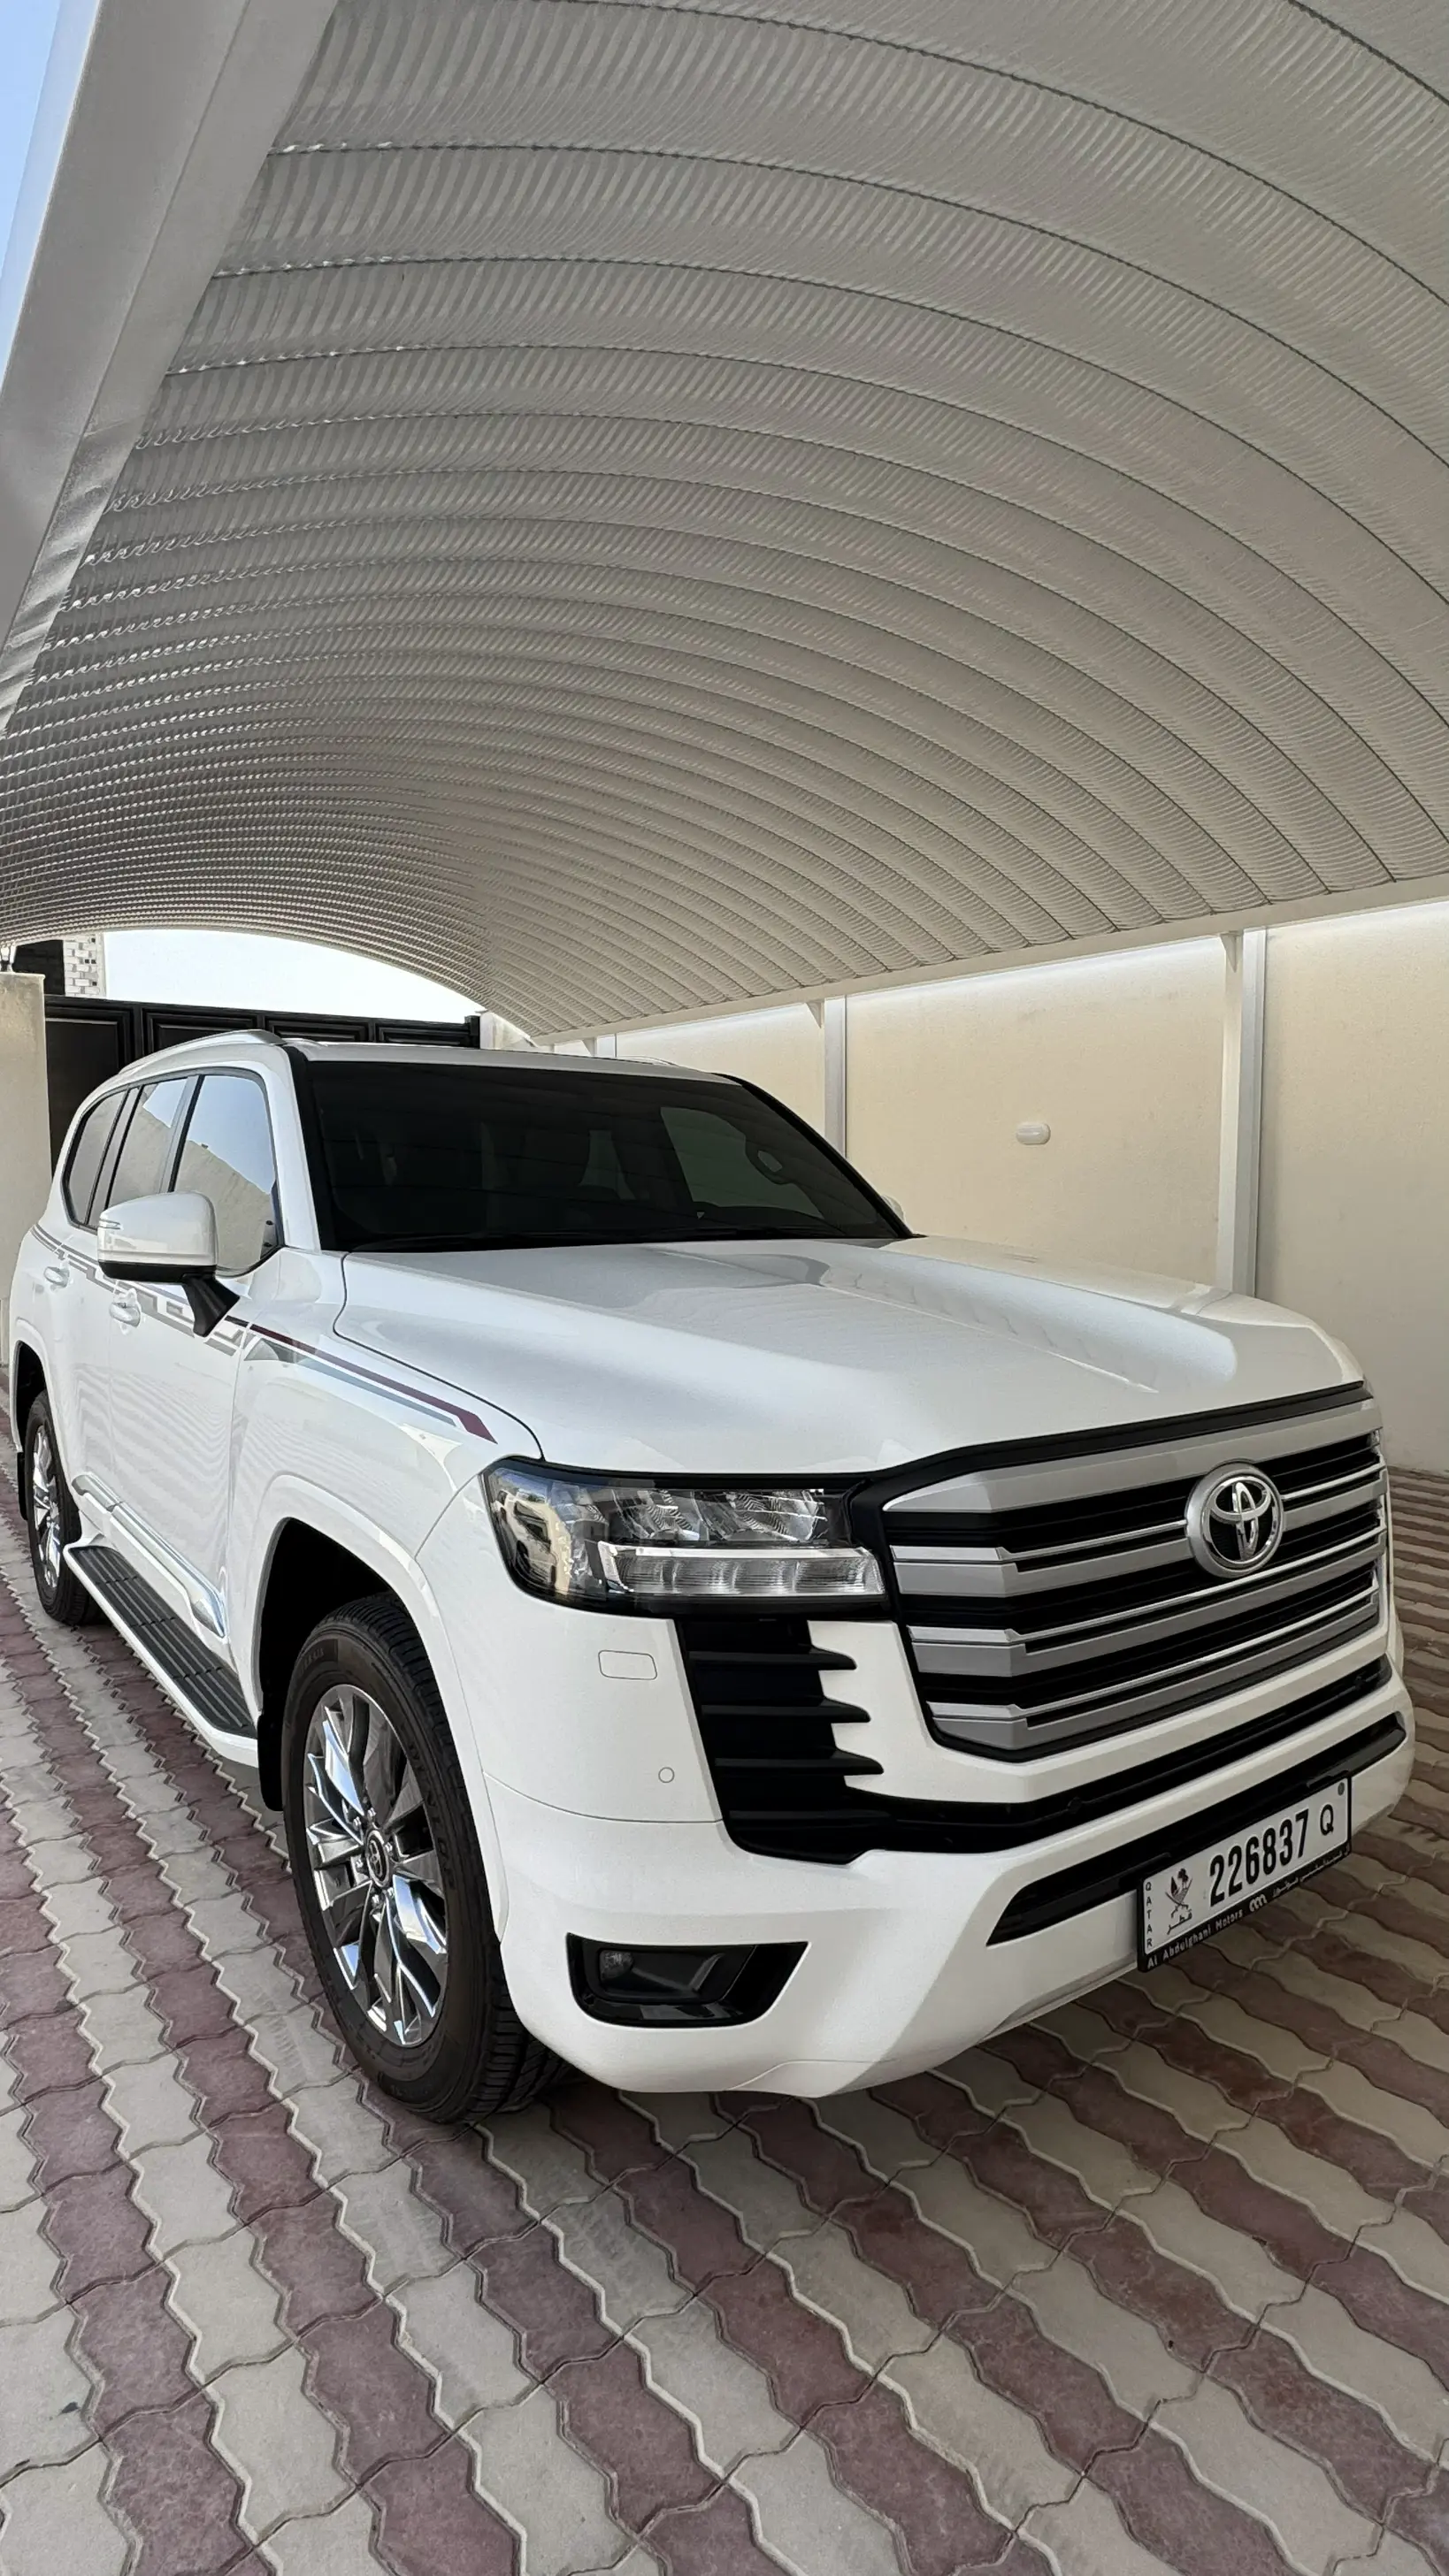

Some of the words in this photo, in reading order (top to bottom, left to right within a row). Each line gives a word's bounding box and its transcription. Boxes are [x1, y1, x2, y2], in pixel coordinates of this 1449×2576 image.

[1209, 1808, 1309, 1907] 226837
[1320, 1803, 1335, 1837] Q
[1145, 1881, 1154, 1949] QATAR
[1147, 1955, 1158, 1969] Al
[1162, 1923, 1212, 1961] Abdulghani
[1215, 1908, 1244, 1930] Motors
